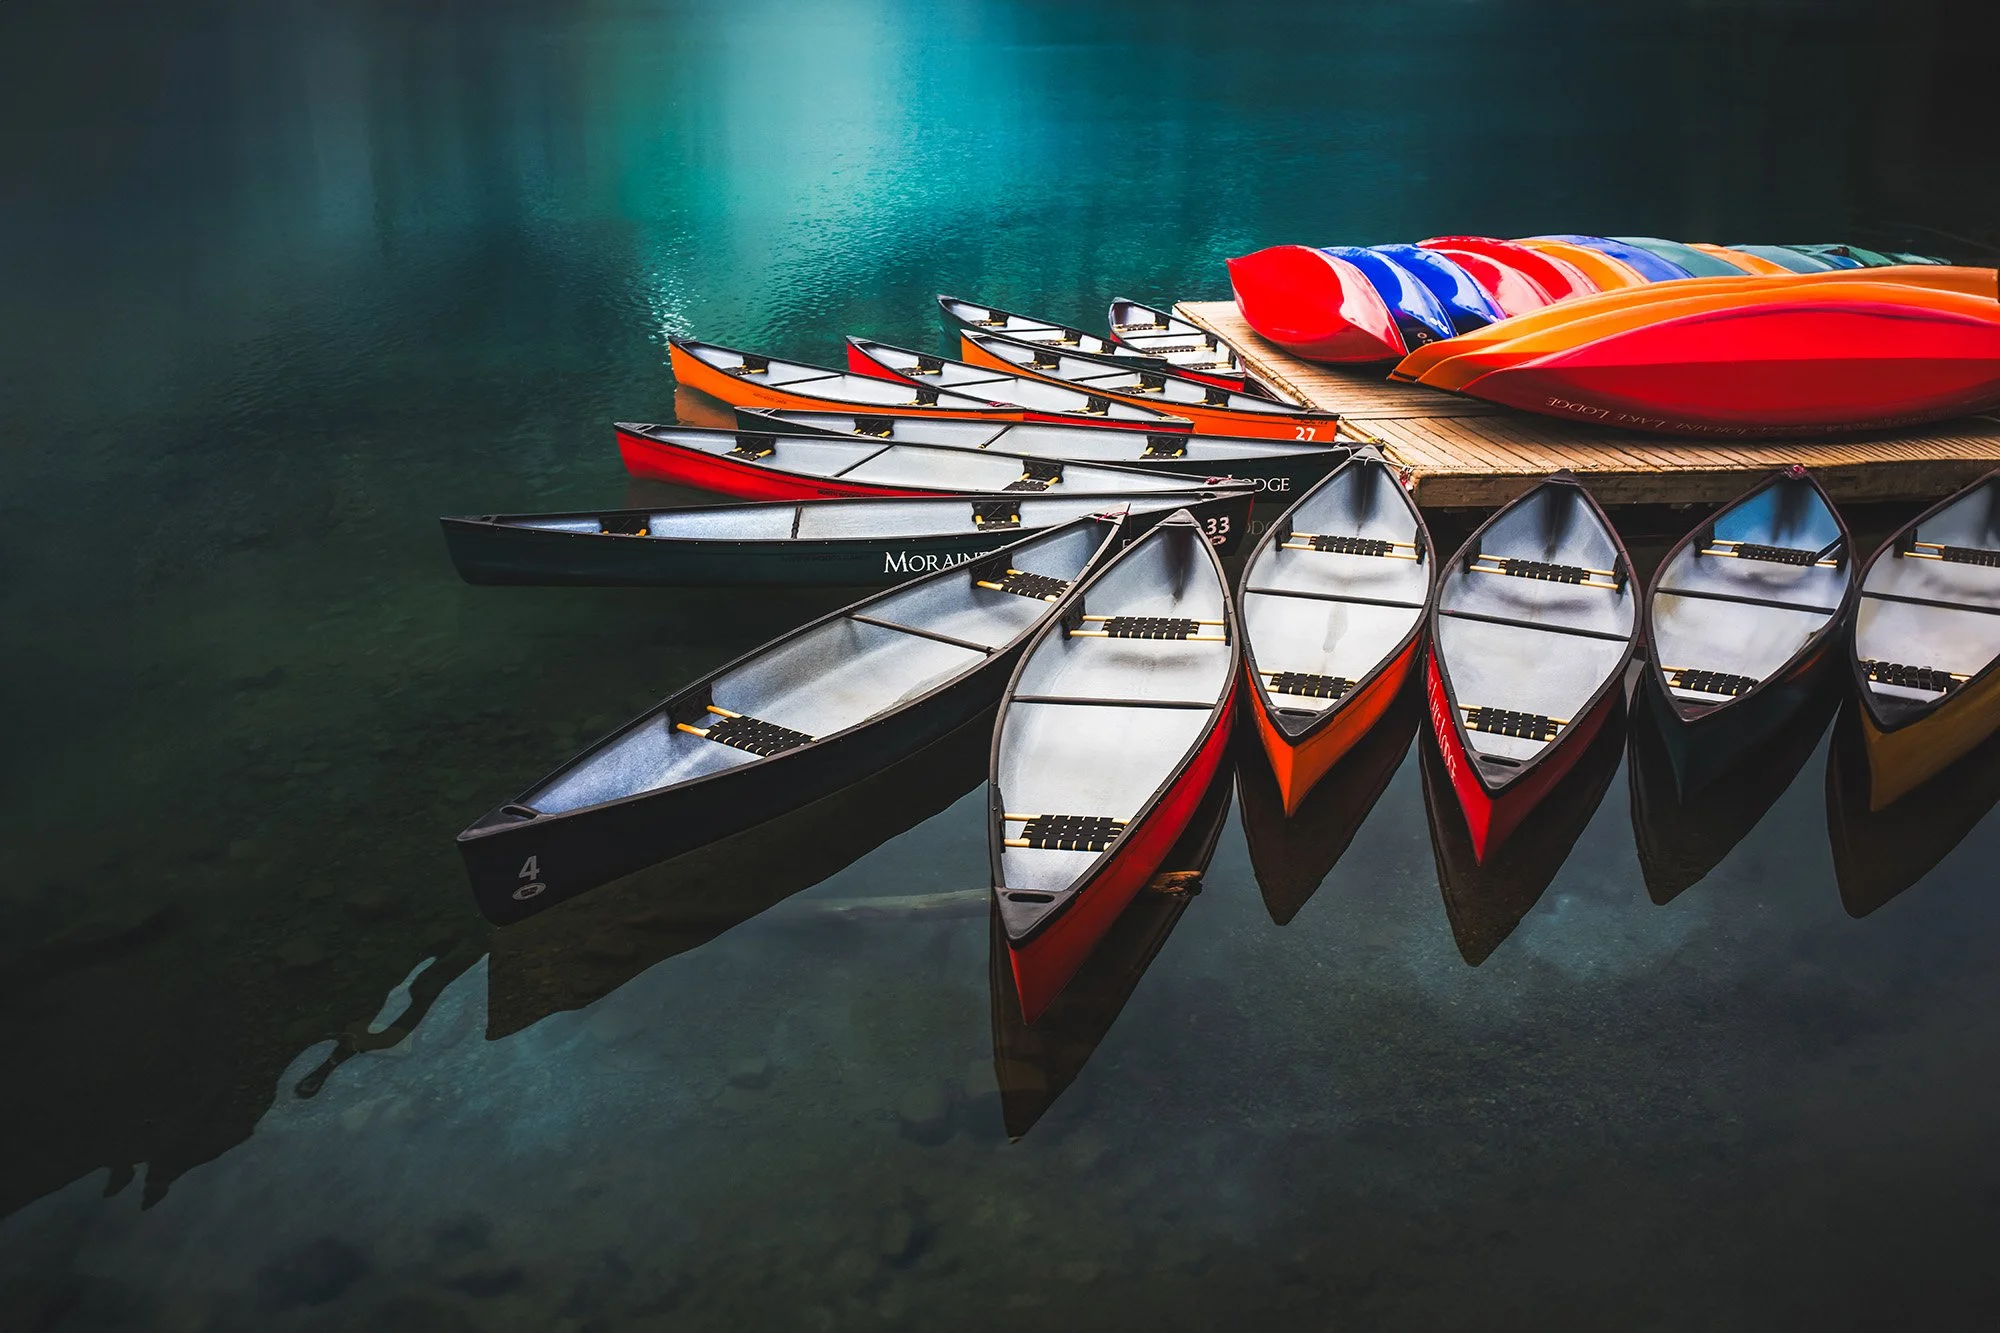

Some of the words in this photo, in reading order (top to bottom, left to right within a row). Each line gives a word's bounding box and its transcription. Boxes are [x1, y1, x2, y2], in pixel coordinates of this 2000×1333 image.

[1546, 397, 1611, 419] LODGE
[1617, 413, 1665, 428] LAKE
[1295, 426, 1316, 441] 27
[1234, 475, 1291, 493] DGE
[1206, 515, 1231, 535] 33
[518, 855, 540, 881] 4
